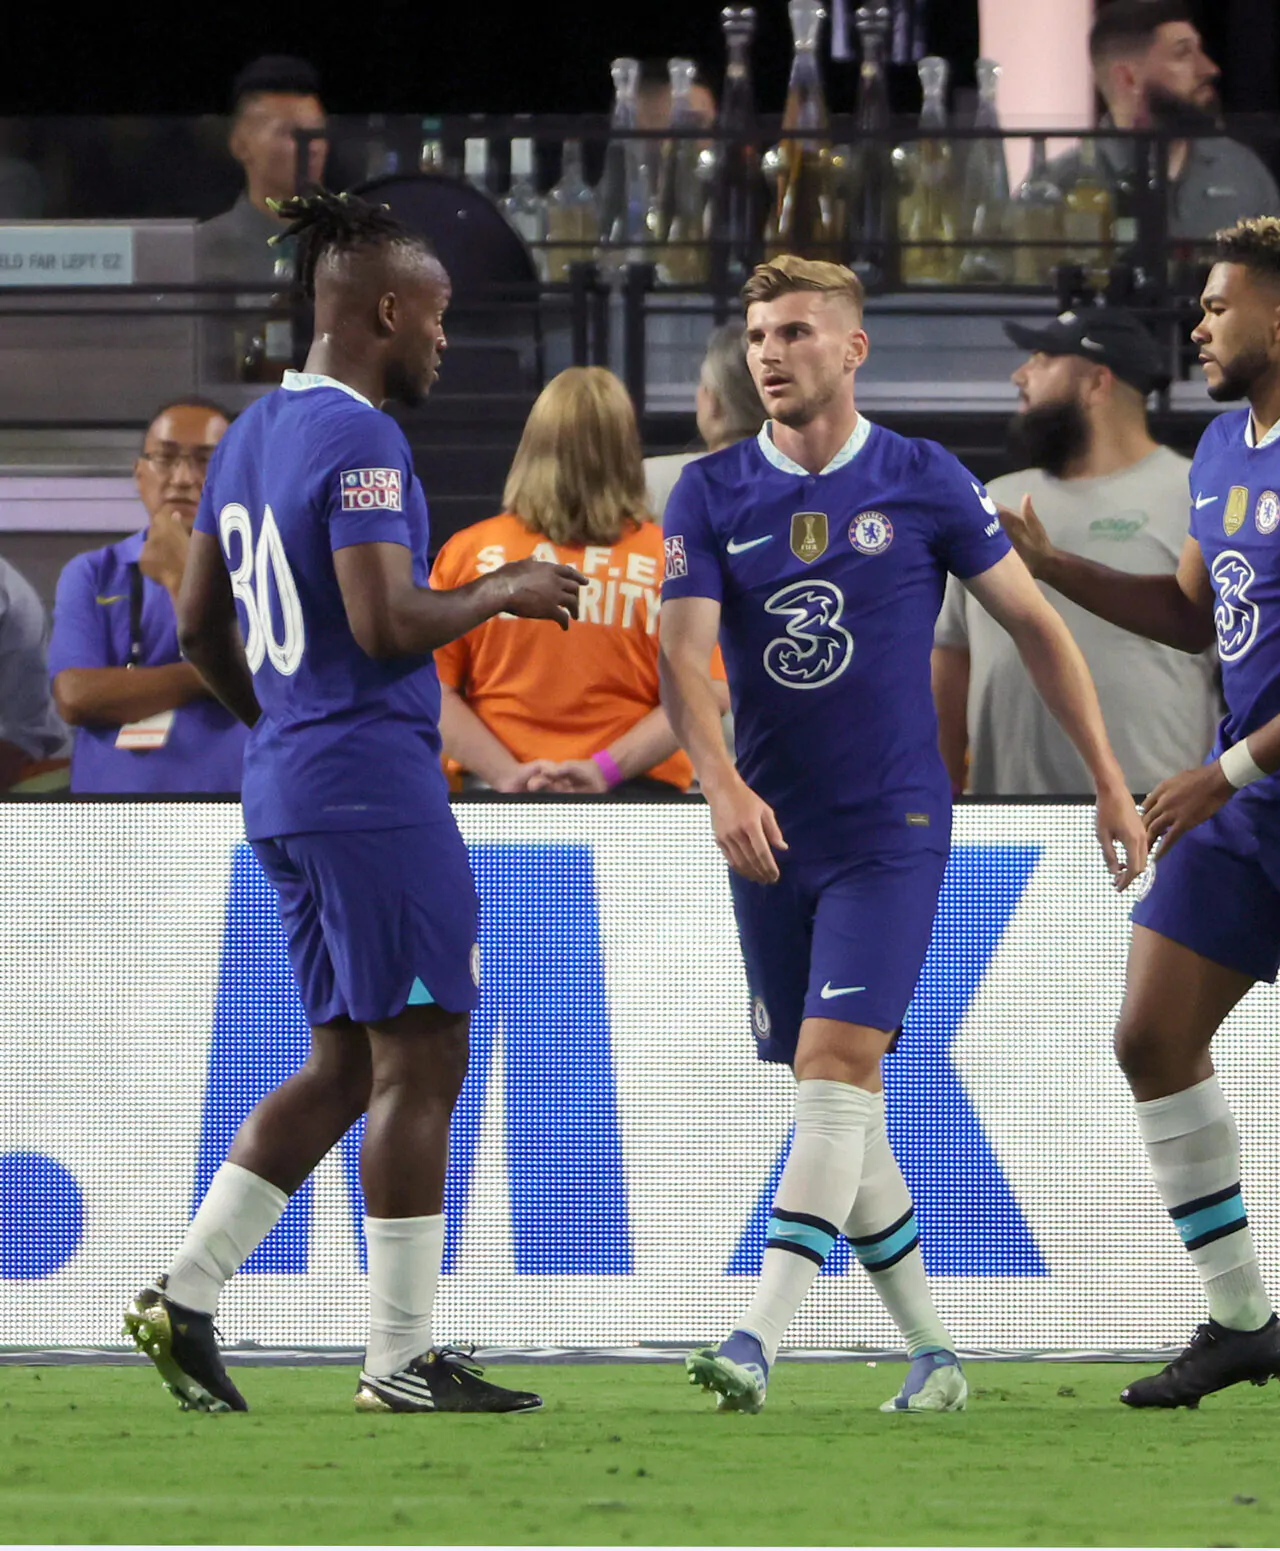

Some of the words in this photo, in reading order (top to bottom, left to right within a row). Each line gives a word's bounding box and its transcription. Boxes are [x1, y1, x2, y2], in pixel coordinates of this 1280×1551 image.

[28, 253, 56, 270] FAR
[61, 253, 96, 270] LEFT
[359, 470, 399, 488] USA
[344, 490, 398, 508] TOUR
[665, 539, 683, 557] SA
[219, 502, 305, 677] 30
[763, 579, 854, 690] 3
